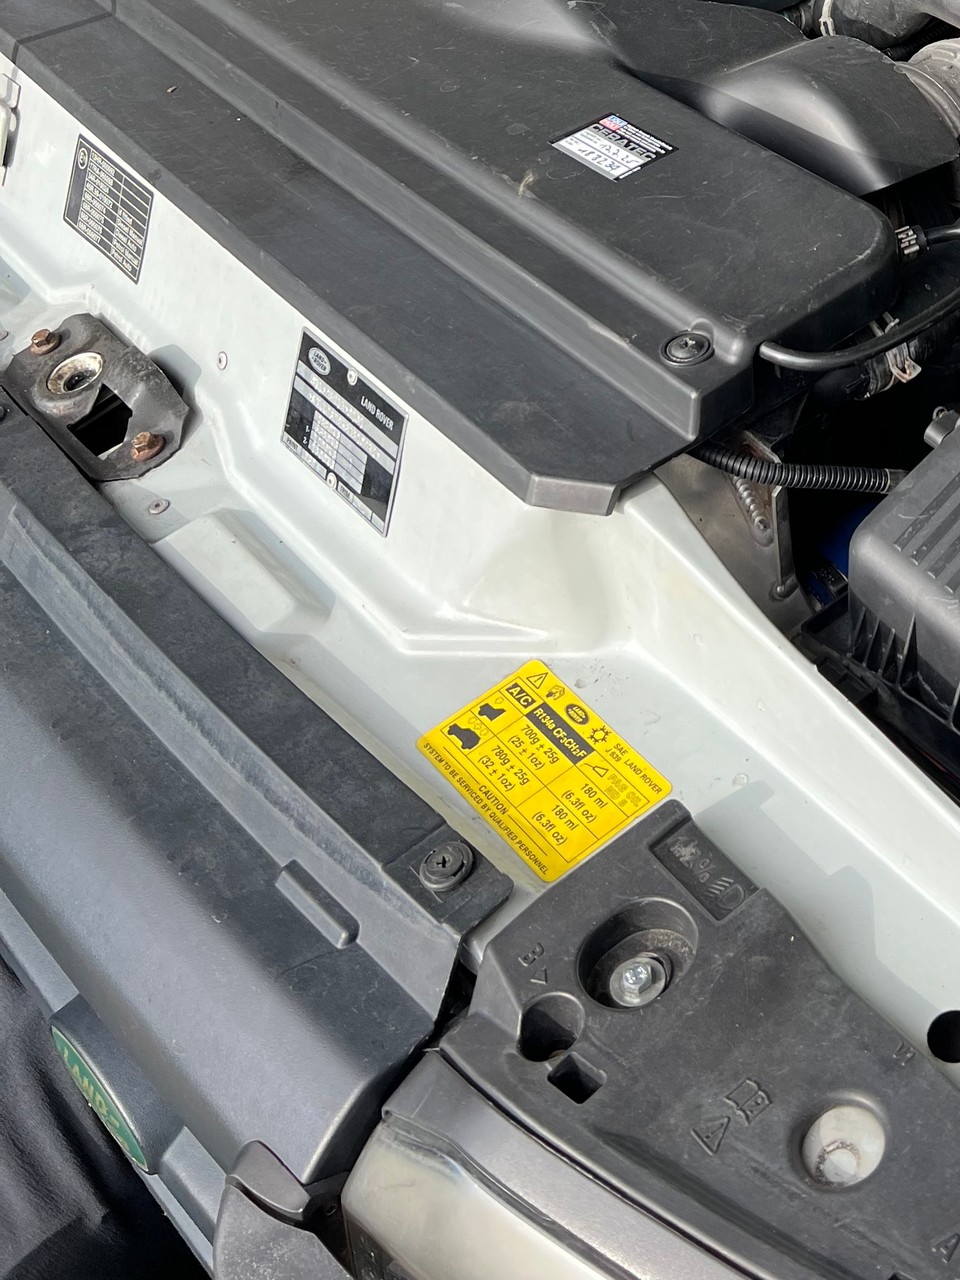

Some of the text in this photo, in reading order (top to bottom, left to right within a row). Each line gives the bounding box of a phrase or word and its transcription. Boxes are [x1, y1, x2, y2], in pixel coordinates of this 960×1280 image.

[313, 349, 324, 363] LAND
[360, 394, 376, 416] LAND
[375, 407, 394, 431] ROVER
[507, 684, 533, 707] A/C
[571, 704, 585, 717] LAND
[532, 707, 557, 730] R134a
[567, 709, 583, 723] ROVER
[506, 734, 525, 750] (25
[524, 751, 546, 771] 1oz)
[517, 724, 542, 745] 700g
[540, 746, 561, 765] 25g
[612, 742, 629, 756] SAE
[476, 754, 495, 770] (32
[495, 772, 517, 792] 1oz)
[488, 744, 512, 766] 780g
[510, 767, 531, 786] 25g
[623, 758, 662, 795] LAND ROVER
[477, 784, 509, 815] CAUTION
[560, 788, 598, 824] (6.3fl oz)
[578, 782, 608, 809] 180 ml
[606, 772, 643, 807] PAG OIL
[422, 742, 550, 875] SYSTEM TO BE SERVICED BY QUALIFIED PERSONNEL
[549, 803, 579, 831] 180 ml
[531, 810, 569, 846] (6.3fl oz)
